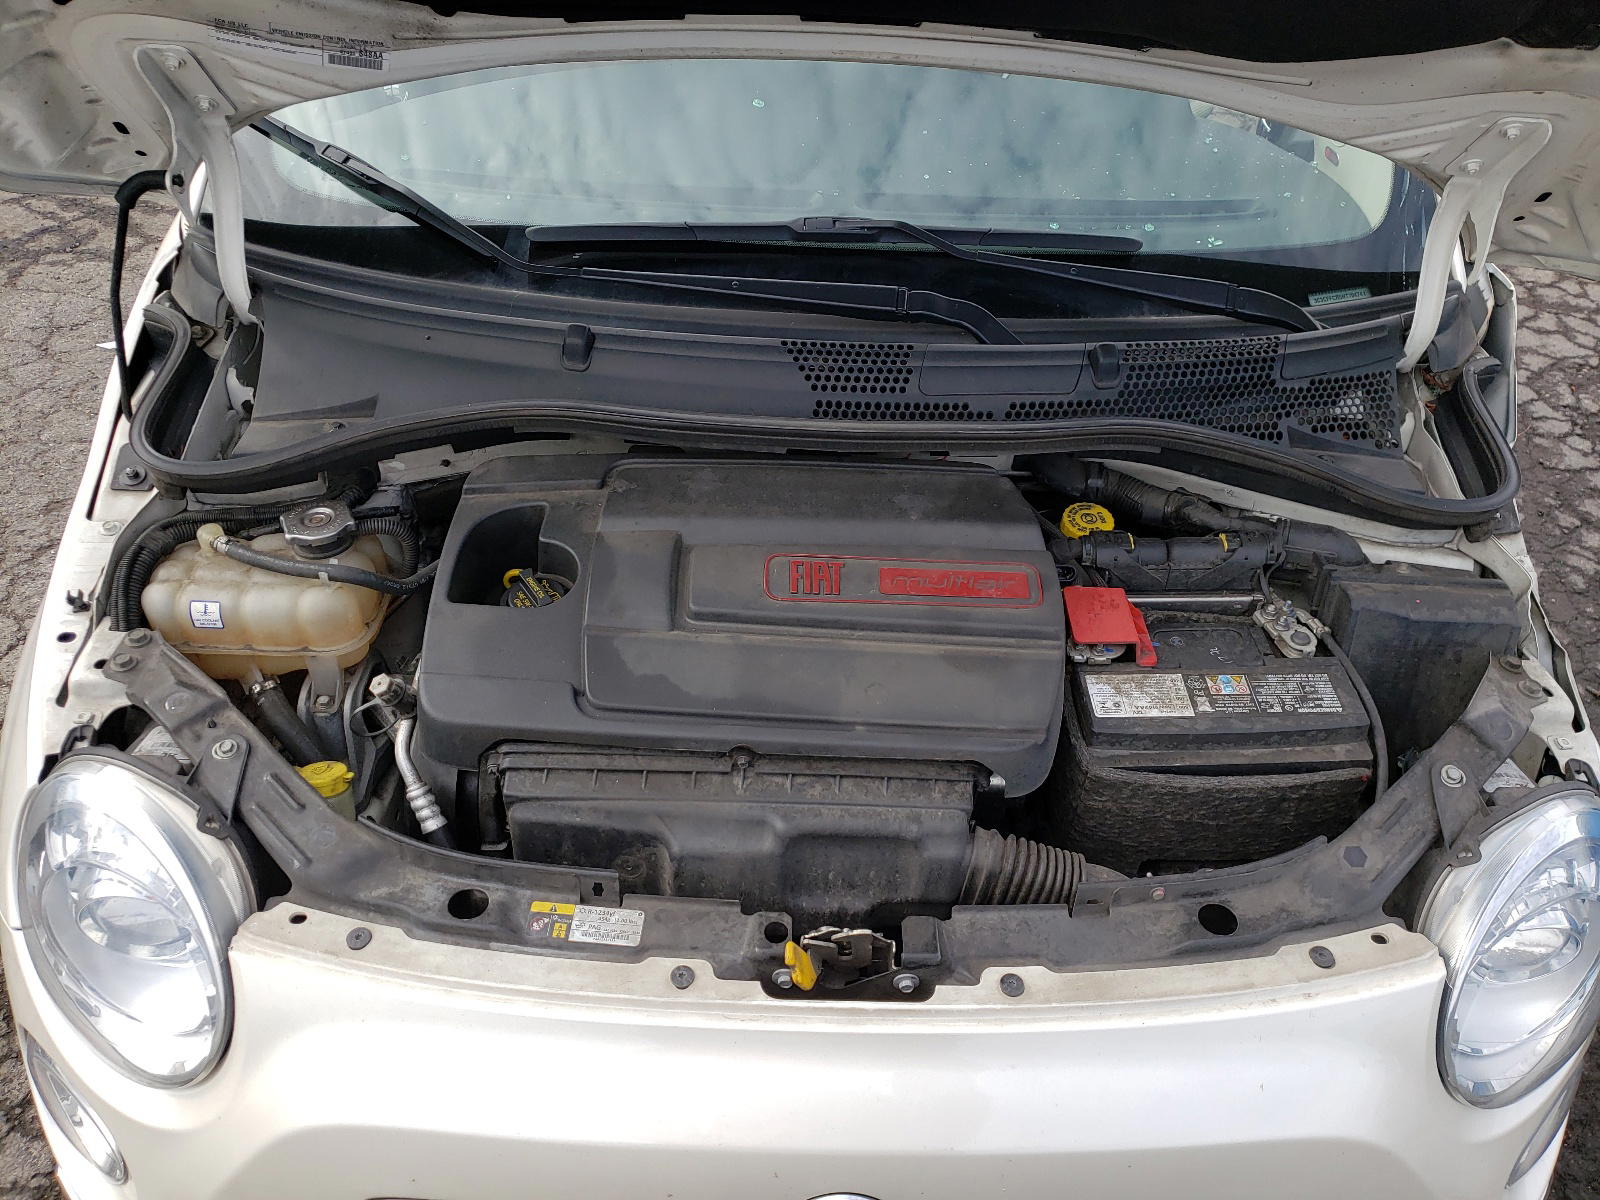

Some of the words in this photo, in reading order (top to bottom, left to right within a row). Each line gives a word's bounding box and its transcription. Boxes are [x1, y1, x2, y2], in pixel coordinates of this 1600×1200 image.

[272, 28, 294, 36] VEHICLE
[295, 31, 321, 39] EMISSION
[322, 35, 349, 43] CONTROL
[349, 38, 385, 46] INFORMATION
[788, 560, 845, 595] FIAT
